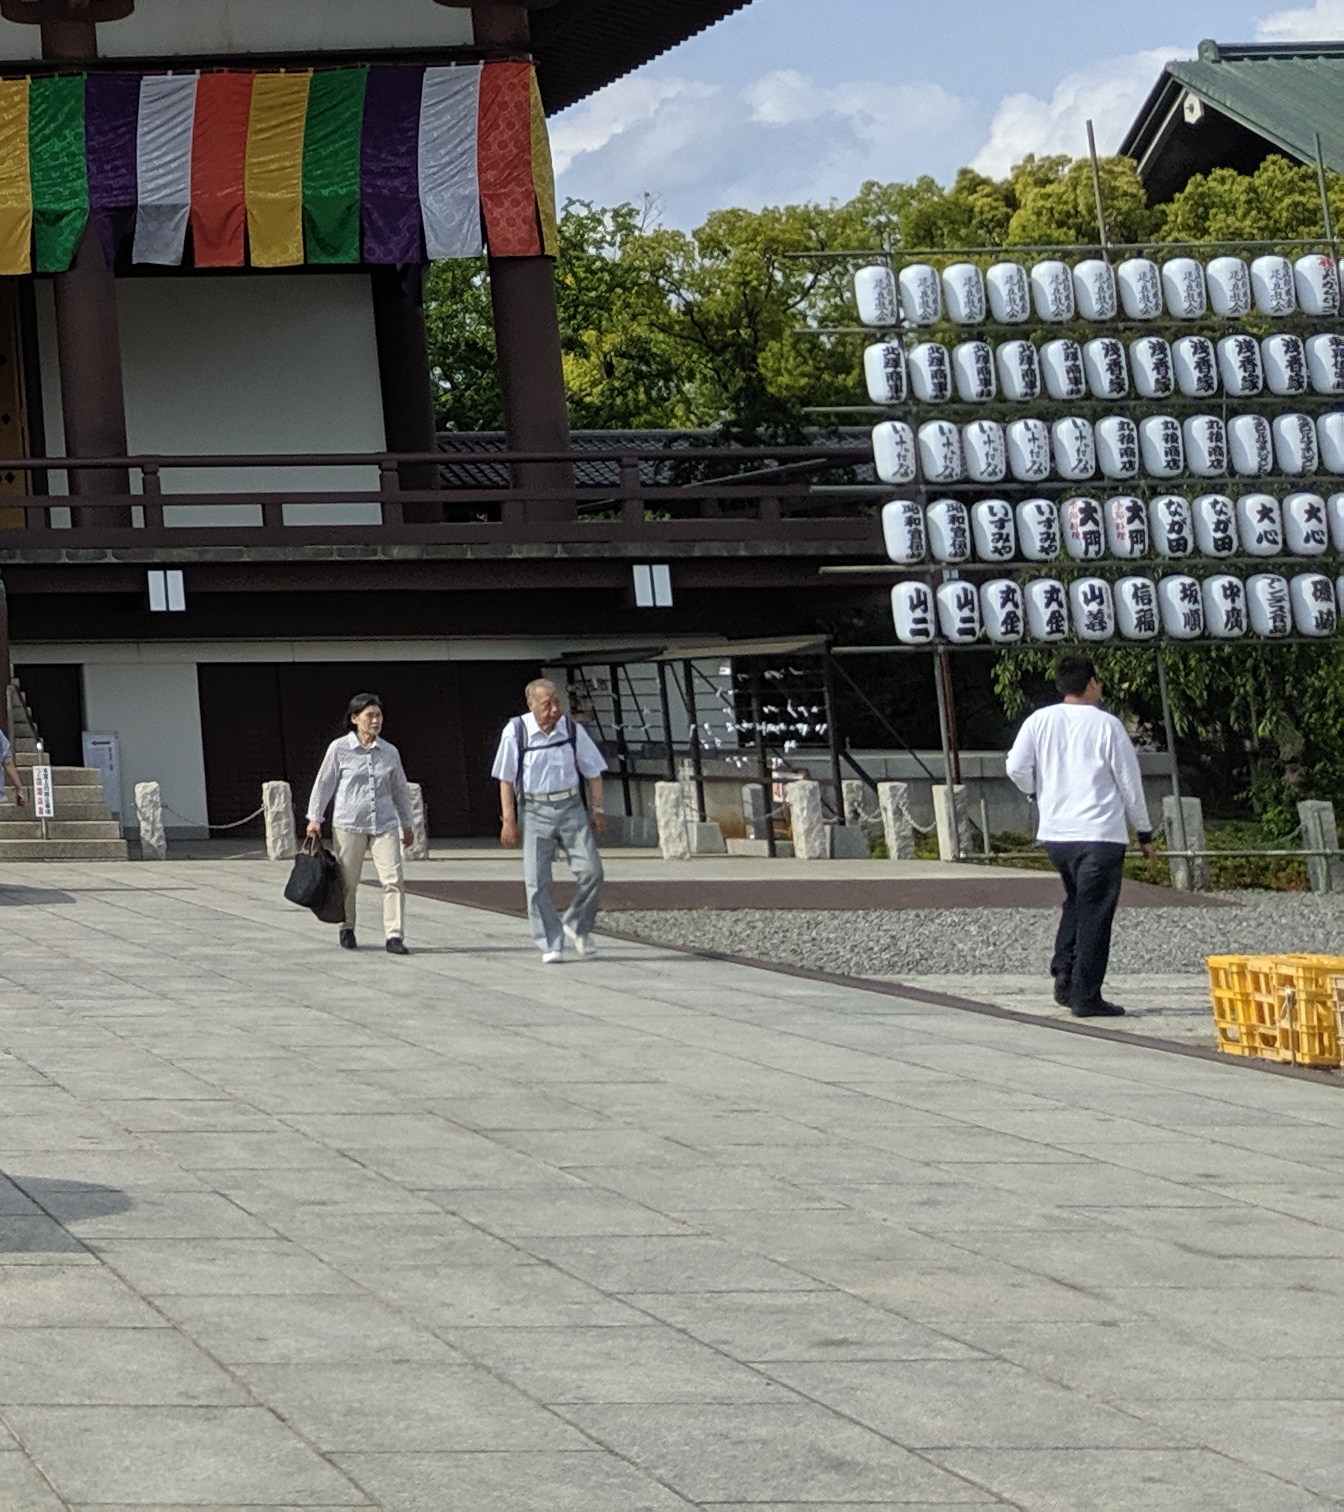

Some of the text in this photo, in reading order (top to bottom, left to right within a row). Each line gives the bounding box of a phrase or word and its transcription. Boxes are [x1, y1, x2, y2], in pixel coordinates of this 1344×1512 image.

[1078, 500, 1102, 557] 大門
[1125, 499, 1147, 555] 大門
[1163, 498, 1188, 553] なが田
[1208, 497, 1233, 553] なが田
[1256, 502, 1280, 545] 大心
[1303, 501, 1325, 545] 大心
[908, 586, 930, 638] 山二
[955, 586, 976, 638] 山二
